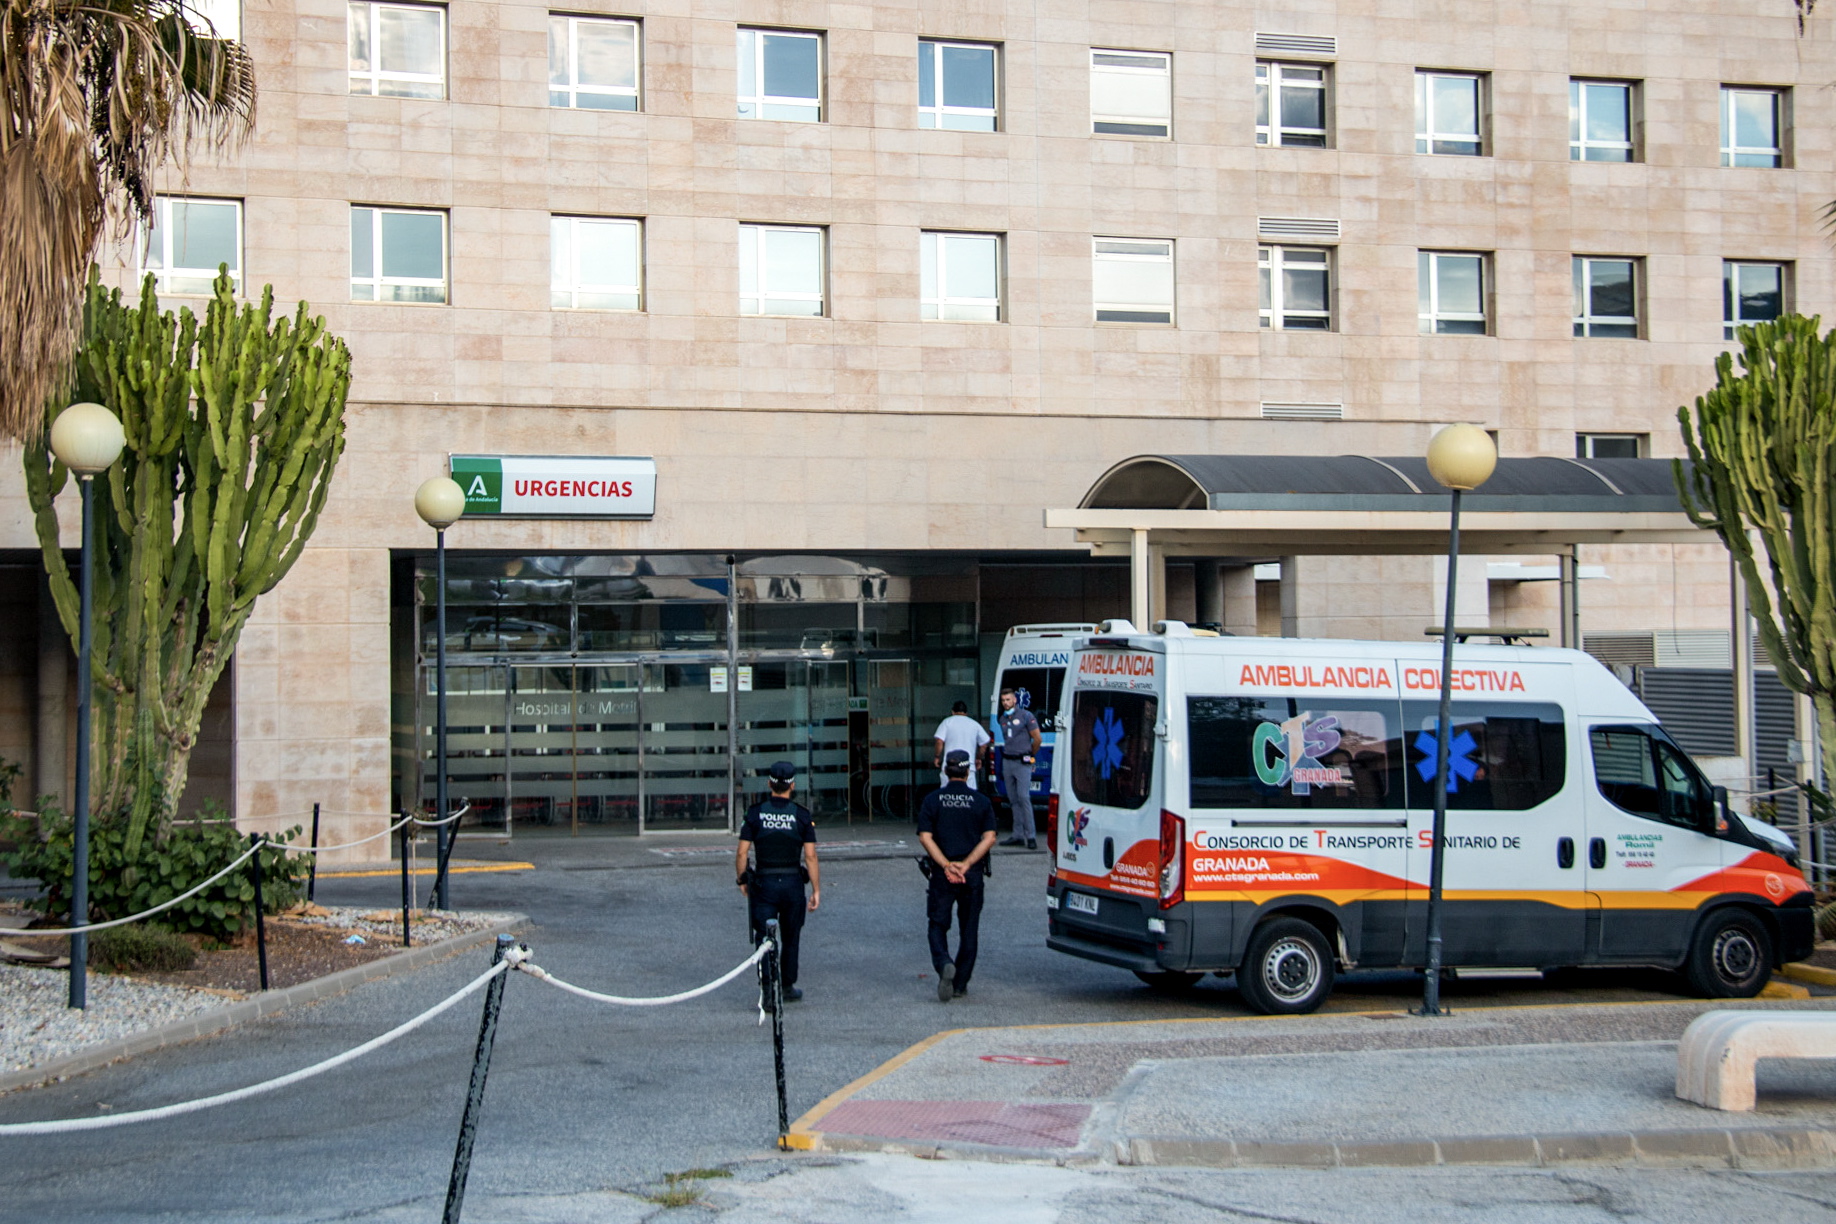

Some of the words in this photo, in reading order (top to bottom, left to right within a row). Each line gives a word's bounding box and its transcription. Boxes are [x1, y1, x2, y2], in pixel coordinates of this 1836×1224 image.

[515, 480, 633, 498] URGENCIAS
[1078, 654, 1154, 677] AMBULANCIA
[1239, 664, 1392, 689] AMBULANCIA
[1404, 668, 1526, 692] COLECTIVA
[514, 701, 571, 717] Hospital
[1252, 712, 1341, 785] CTS
[1293, 768, 1341, 783] GRANADA
[939, 794, 974, 802] POLICIA
[942, 800, 971, 808] LOCAL
[759, 812, 796, 823] POLICIA
[763, 820, 793, 830] LOCAL
[1193, 830, 1284, 849] CONSORCIO
[1290, 836, 1308, 848] DE
[1313, 830, 1413, 849] TRANSPORTE
[1418, 830, 1497, 848] SNITARIO
[1503, 836, 1521, 848] DE
[1116, 862, 1148, 877] GRANADA
[1193, 857, 1270, 872] GRANADA
[1193, 871, 1319, 884] www.ctsgranada.com
